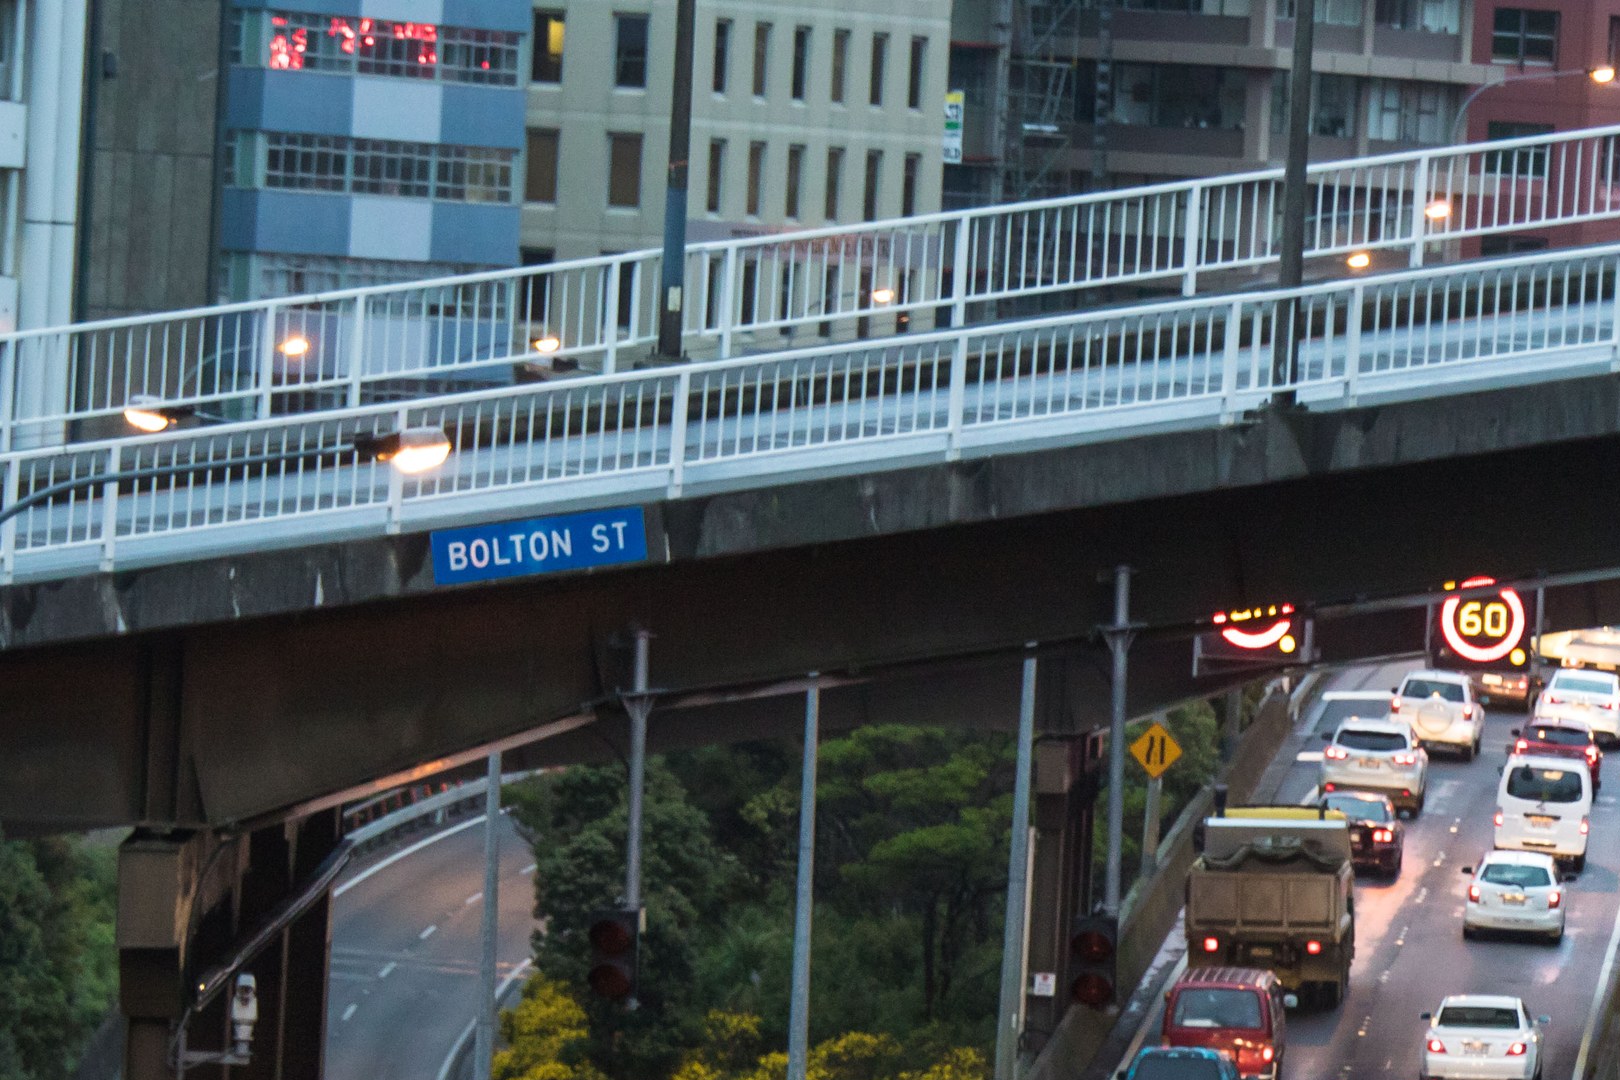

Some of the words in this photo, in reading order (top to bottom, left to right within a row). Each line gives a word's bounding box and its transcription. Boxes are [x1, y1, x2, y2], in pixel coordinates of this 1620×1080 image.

[448, 528, 572, 572] BOLTON
[591, 521, 628, 553] ST
[1459, 600, 1508, 637] 60
